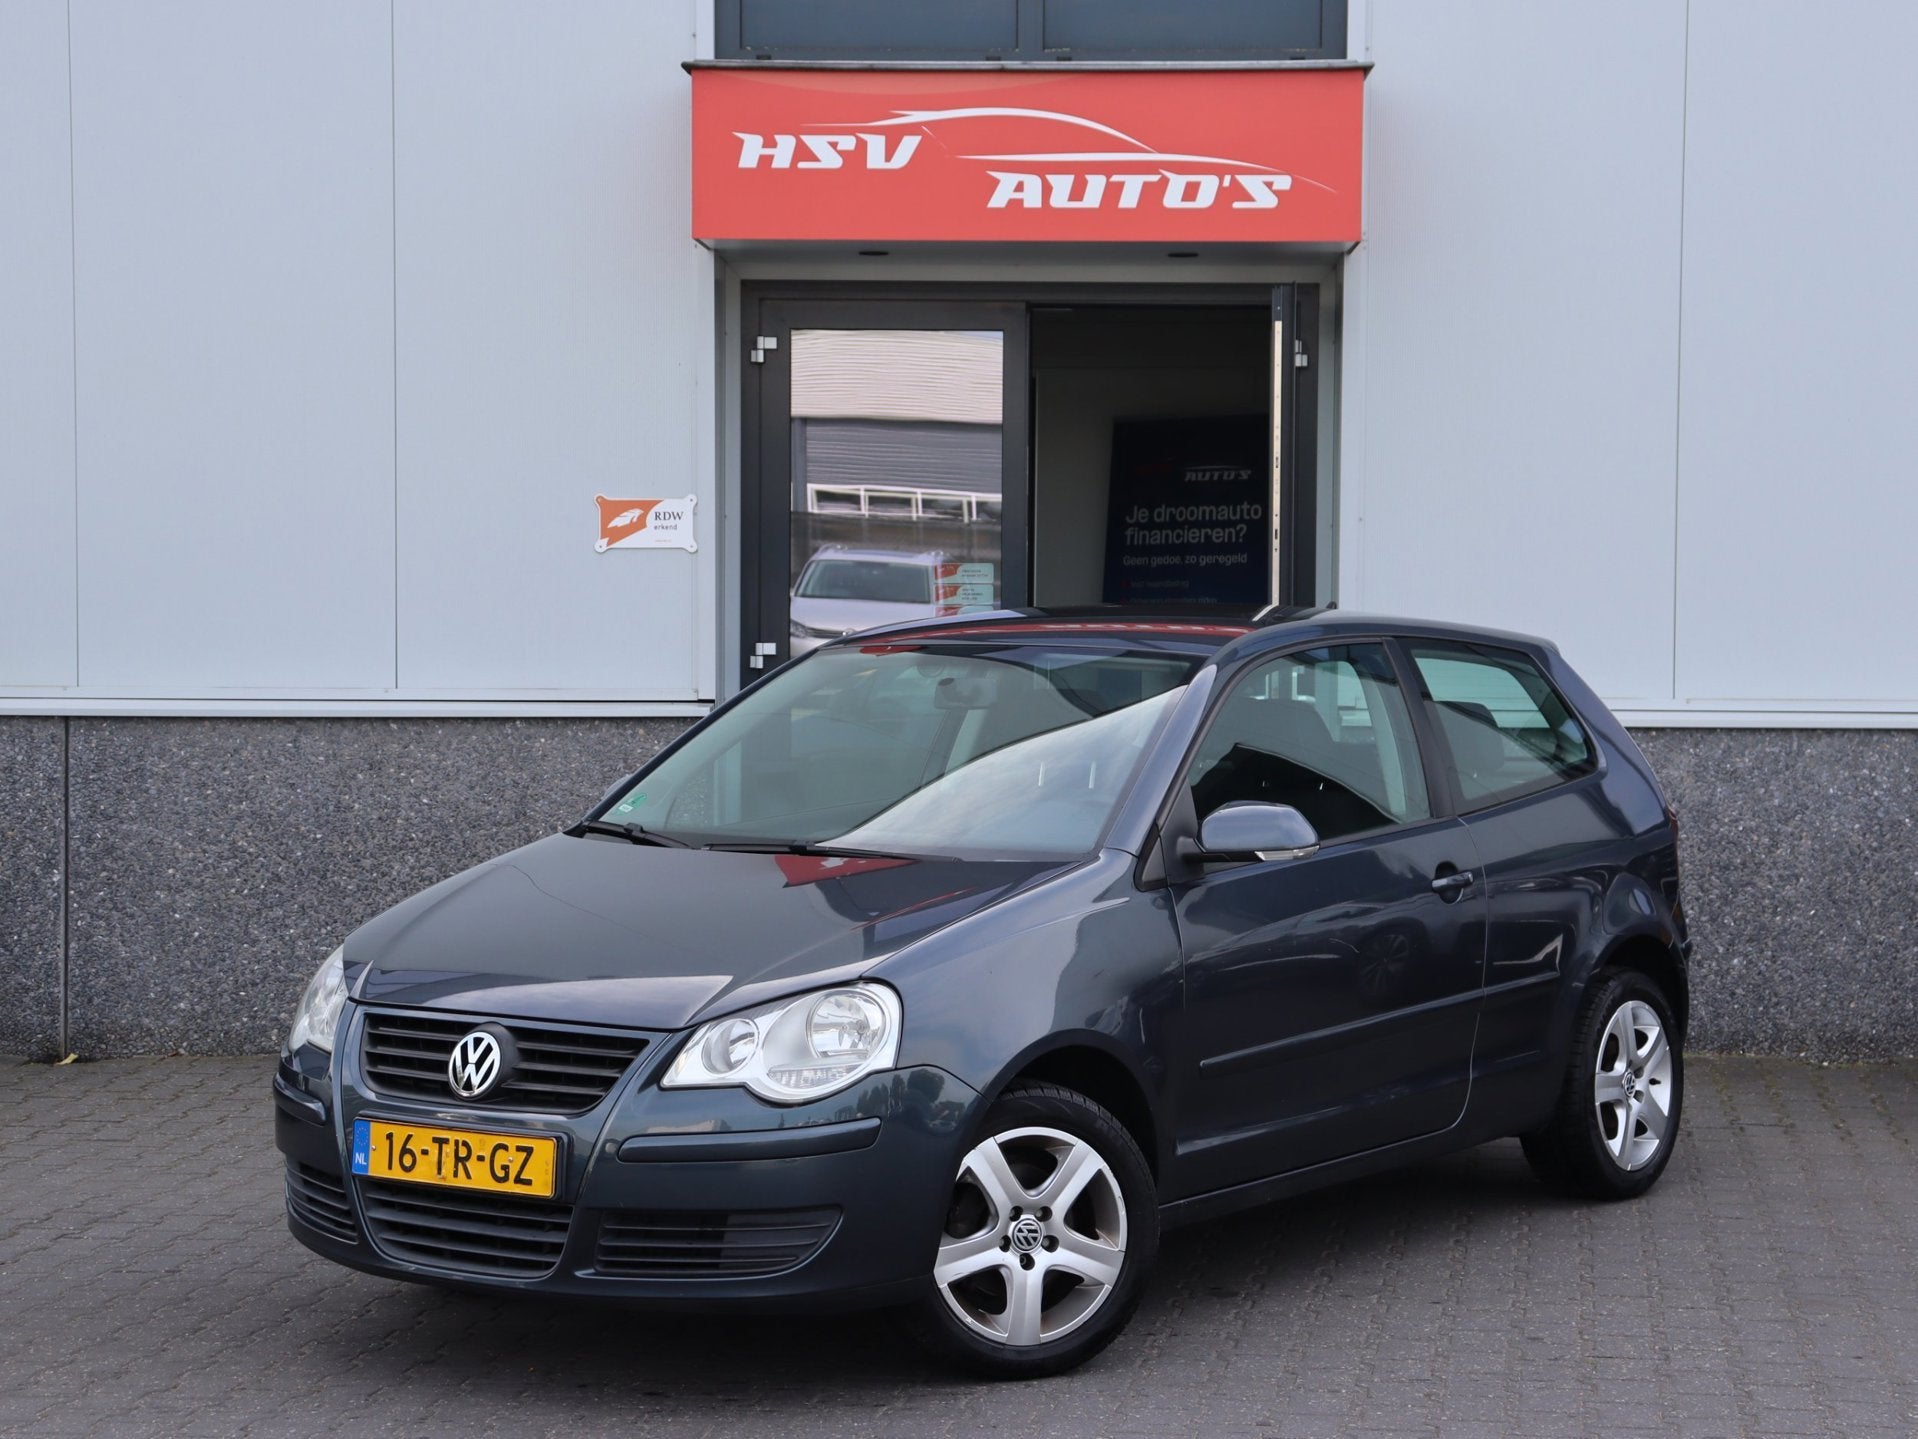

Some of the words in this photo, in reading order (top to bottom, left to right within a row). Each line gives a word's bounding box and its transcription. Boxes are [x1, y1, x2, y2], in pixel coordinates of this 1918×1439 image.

[732, 132, 922, 169] HSV
[986, 169, 1293, 209] AUTO'S
[654, 511, 684, 521] RDW
[1125, 505, 1149, 523] Je
[1154, 501, 1262, 522] droomauto
[1125, 524, 1247, 545] financieren?
[1123, 556, 1149, 566] Geen
[1185, 556, 1197, 565] zo
[1200, 553, 1247, 566] geregeld
[450, 1031, 501, 1097] VW
[355, 1153, 367, 1165] NL
[386, 1131, 534, 1186] 16-TR-GZ
